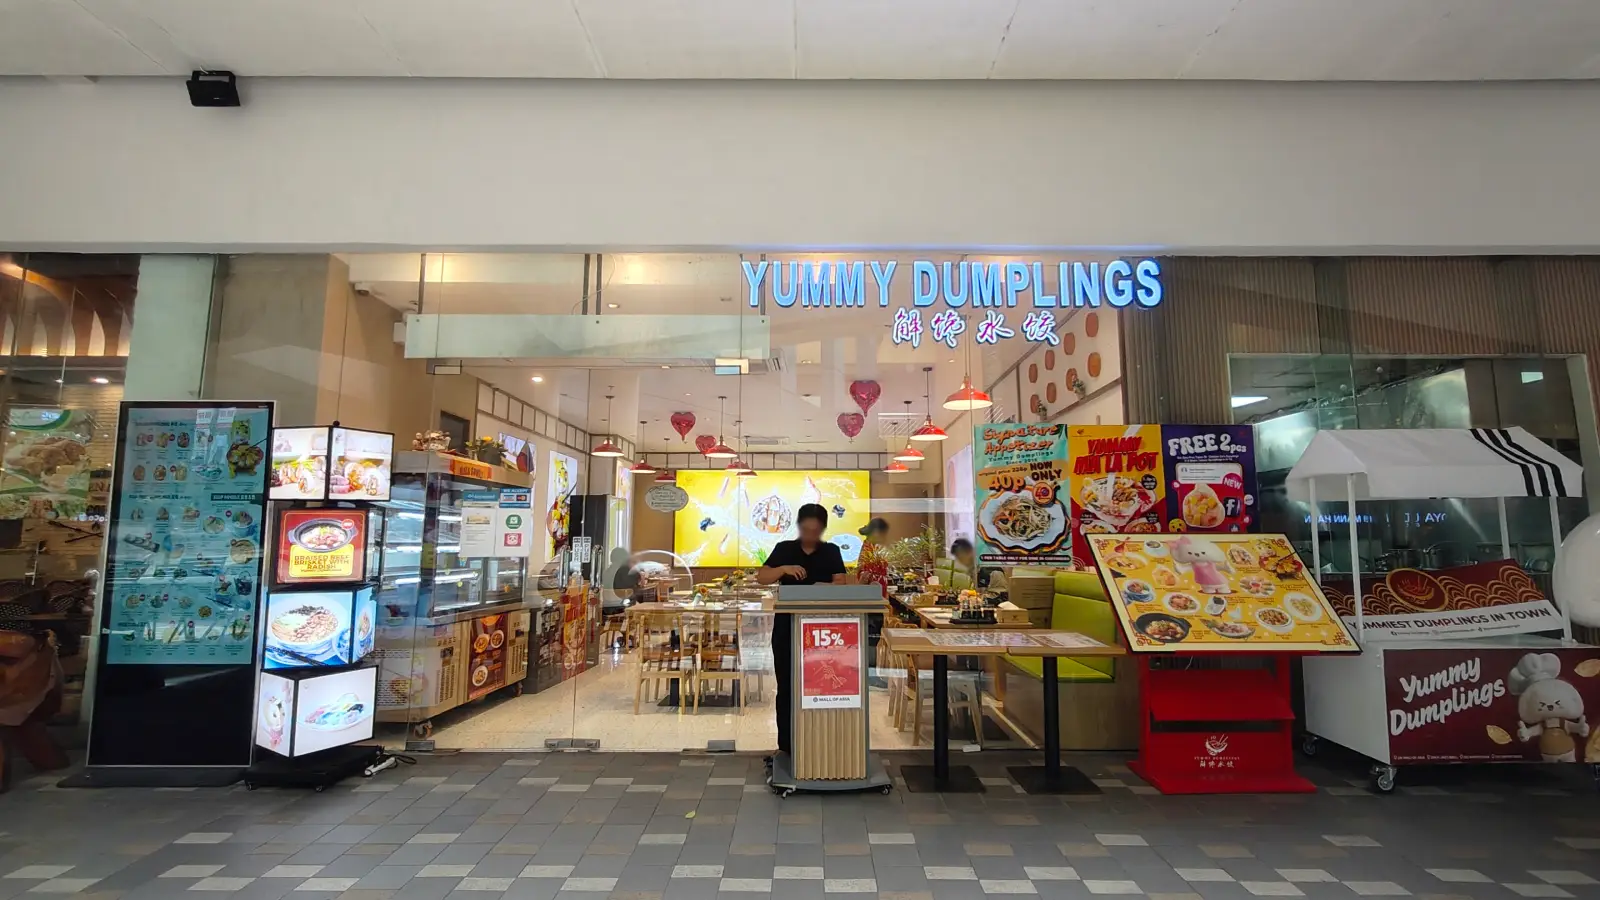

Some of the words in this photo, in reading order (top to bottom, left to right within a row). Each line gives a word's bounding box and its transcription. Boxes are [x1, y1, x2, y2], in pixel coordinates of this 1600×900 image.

[741, 259, 897, 307] YUMMY
[913, 257, 1164, 309] DUMPLINGS
[983, 425, 1059, 445] Signature
[1168, 433, 1219, 457] FREE
[984, 440, 1054, 457] Appetizer
[1087, 436, 1143, 455] YUMMY
[1030, 461, 1053, 471] NOW
[1126, 451, 1159, 472] POT
[1031, 468, 1062, 481] ONLY
[1223, 477, 1242, 490] NEW
[1414, 614, 1489, 629] DUMPLINGS
[1490, 611, 1506, 621] IN
[1506, 607, 1552, 620] TOWN
[812, 629, 844, 647] 15%
[1399, 657, 1481, 703] Yummy
[1390, 678, 1506, 736] Dumplings
